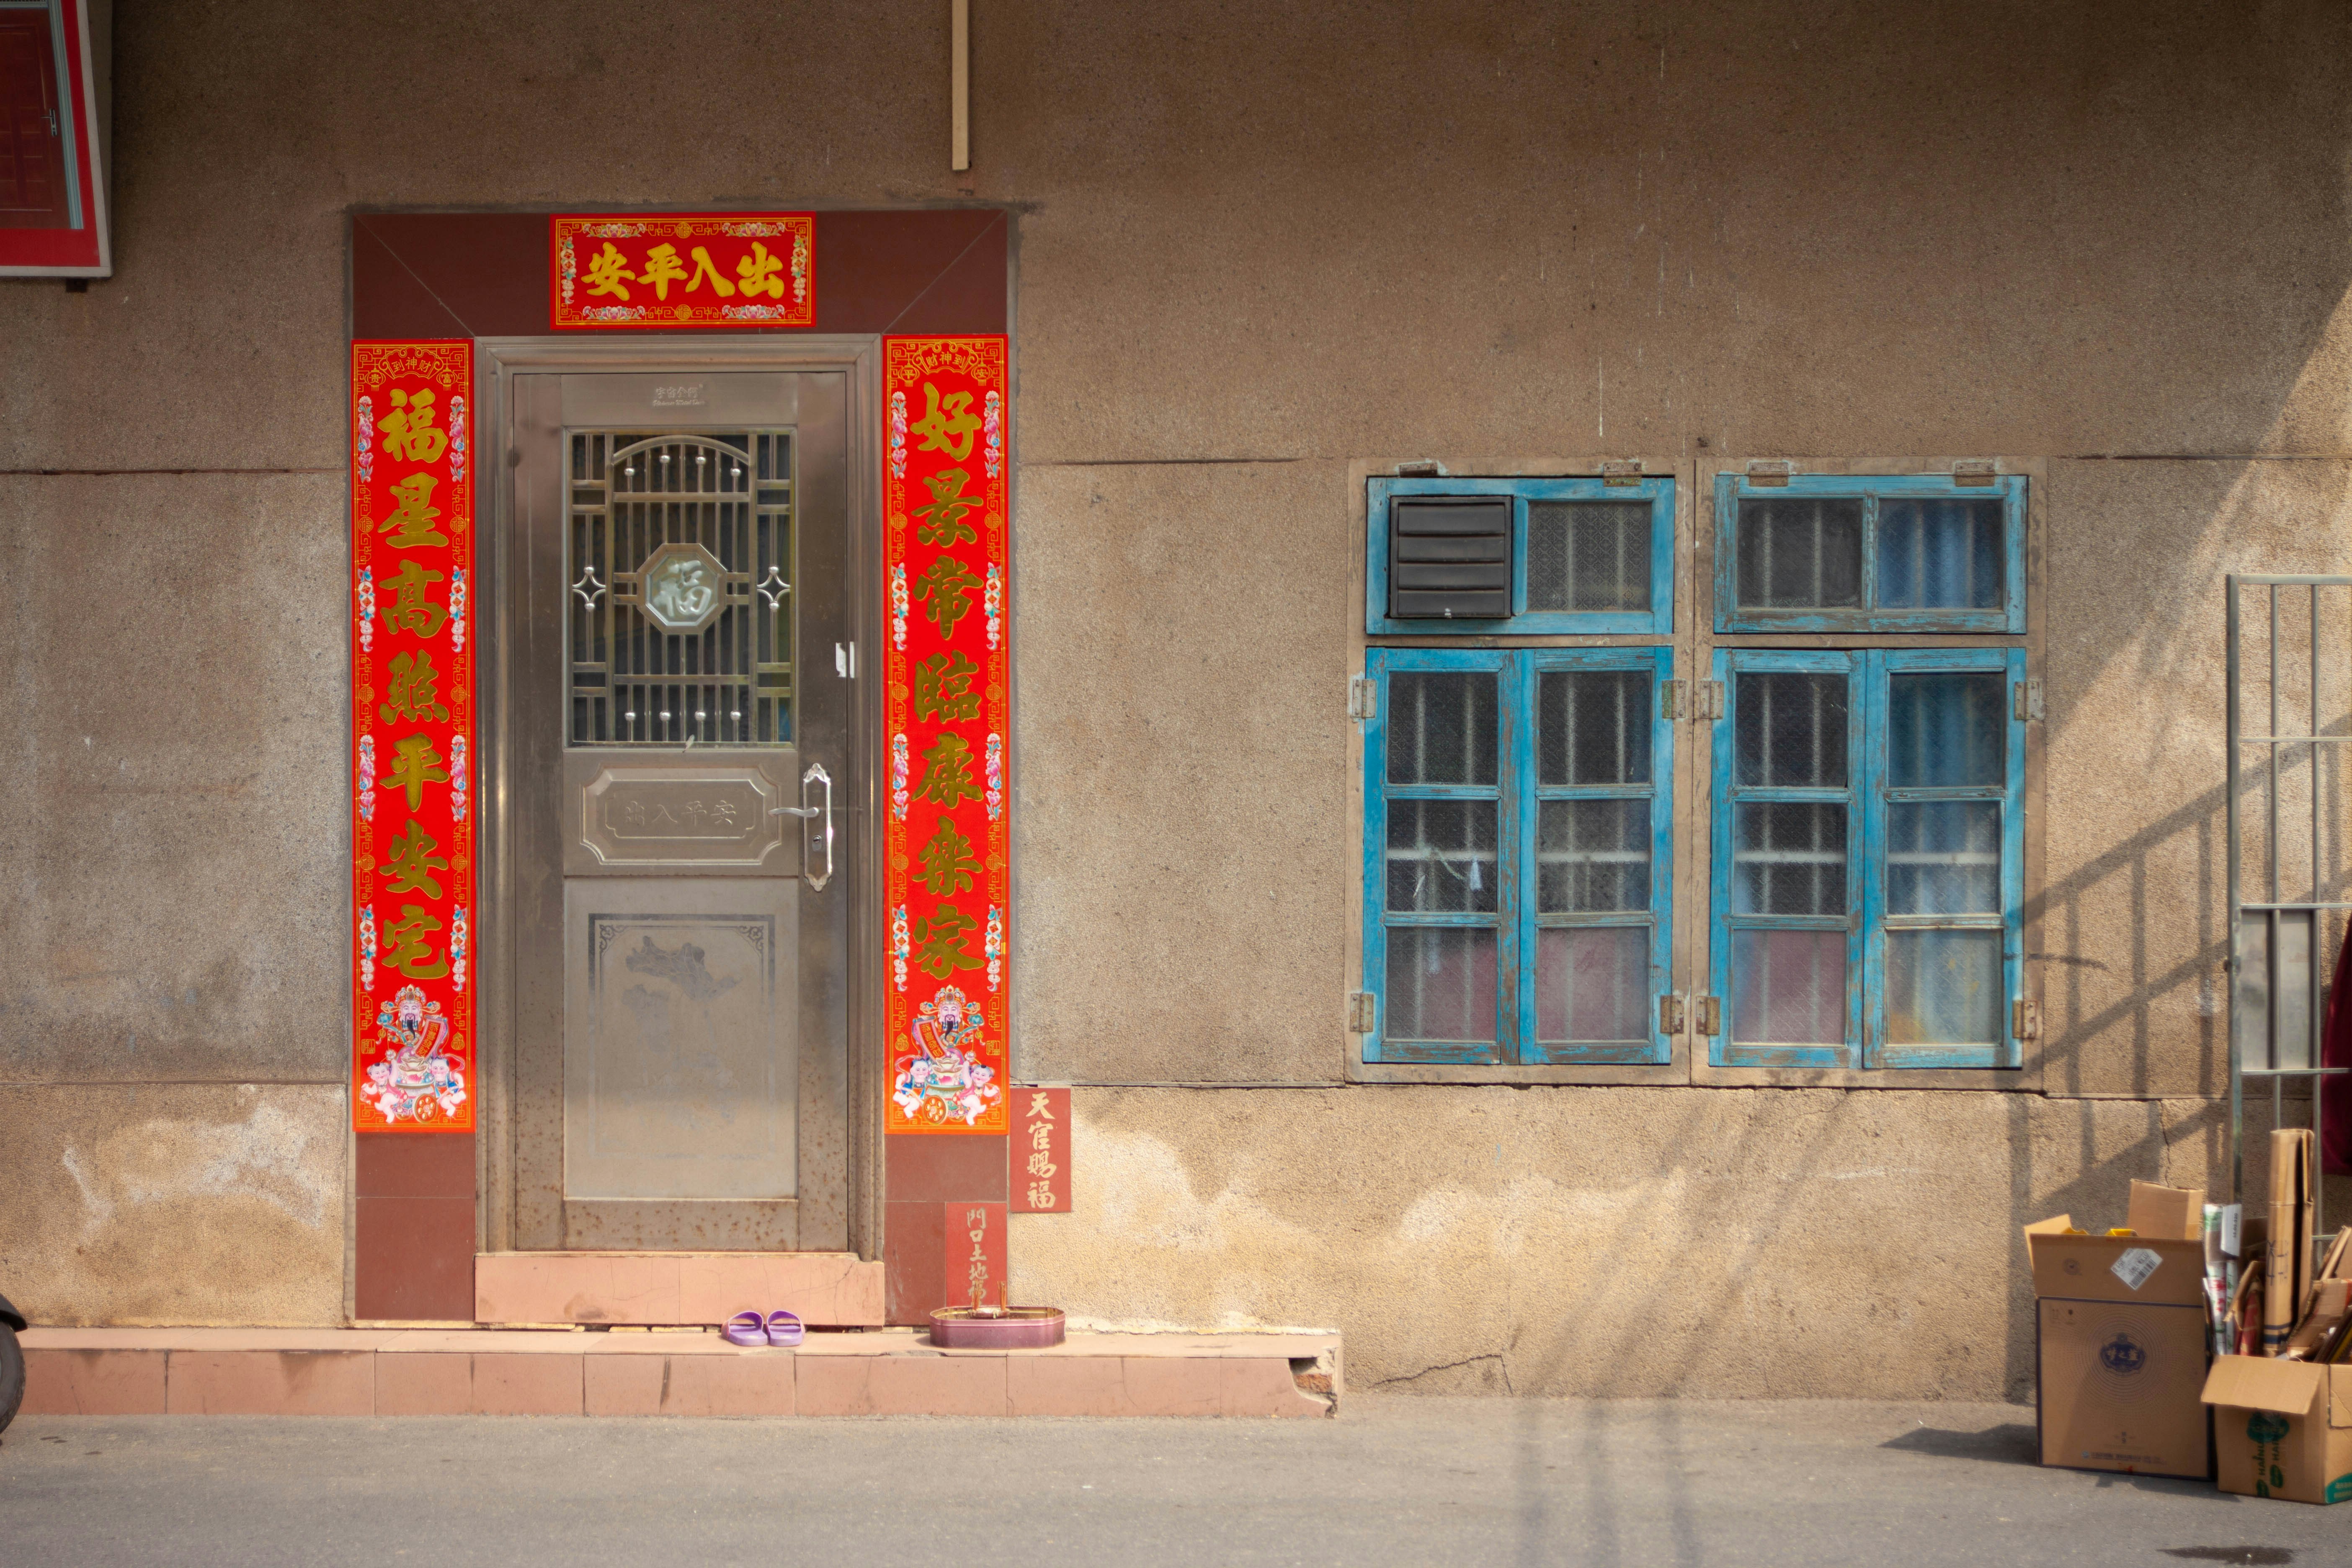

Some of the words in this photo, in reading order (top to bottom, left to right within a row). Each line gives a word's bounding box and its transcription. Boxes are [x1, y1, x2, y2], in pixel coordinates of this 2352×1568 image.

[391, 356, 431, 373] 财神到
[925, 351, 966, 369] 财神到
[369, 373, 381, 384] 贵
[441, 373, 453, 383] 富
[903, 369, 916, 379] 平
[976, 368, 988, 378] 安
[652, 560, 712, 617] 福
[377, 388, 450, 979] 福星高照平安宅
[910, 382, 985, 980] 好景常臨康樂家
[624, 799, 738, 827] 出入平安
[1025, 1091, 1058, 1210] 天官賜福
